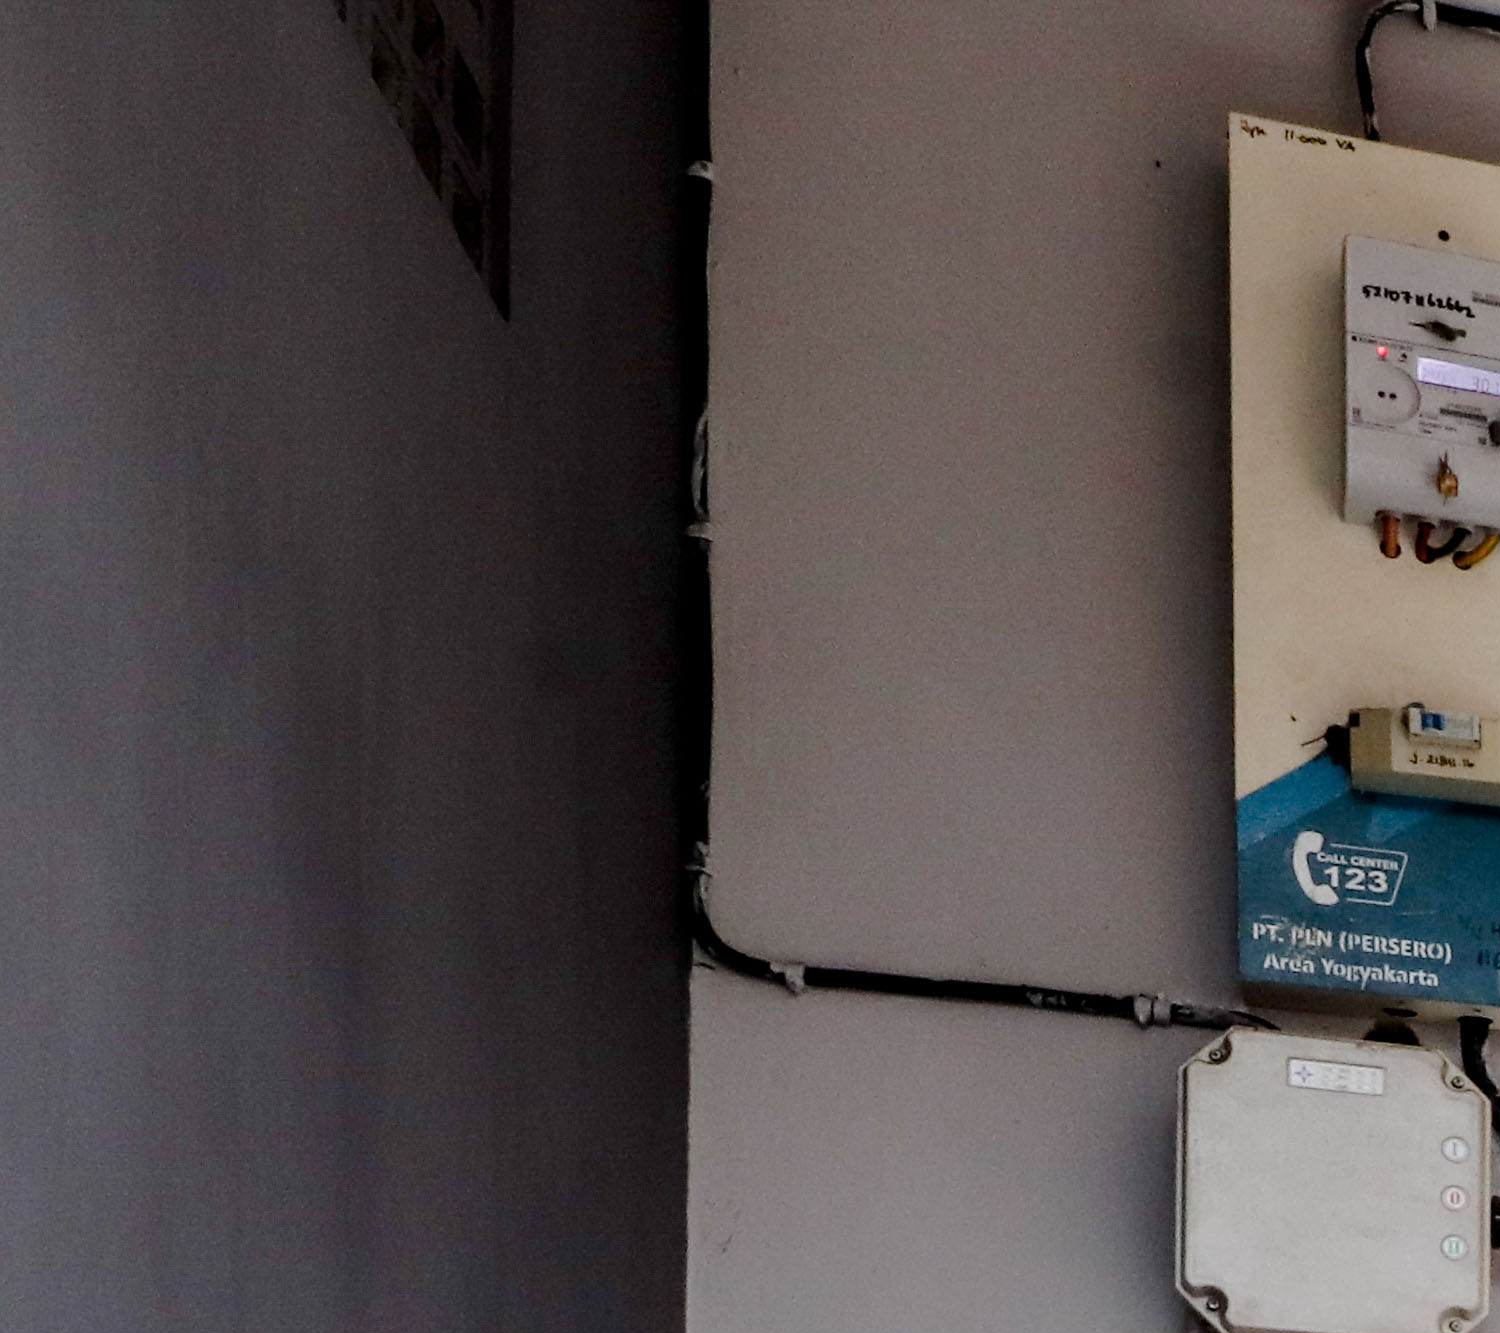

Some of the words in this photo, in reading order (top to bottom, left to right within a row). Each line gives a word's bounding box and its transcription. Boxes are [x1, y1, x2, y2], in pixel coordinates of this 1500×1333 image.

[1316, 851, 1348, 866] CALL
[1350, 855, 1399, 871] CENTER
[1324, 865, 1389, 894] 123
[1252, 921, 1285, 943] PT.
[1290, 924, 1333, 948] PLN
[1338, 930, 1453, 965] (PERSERO)
[1263, 952, 1315, 974] Area
[1320, 956, 1439, 991] Yogyakarta
